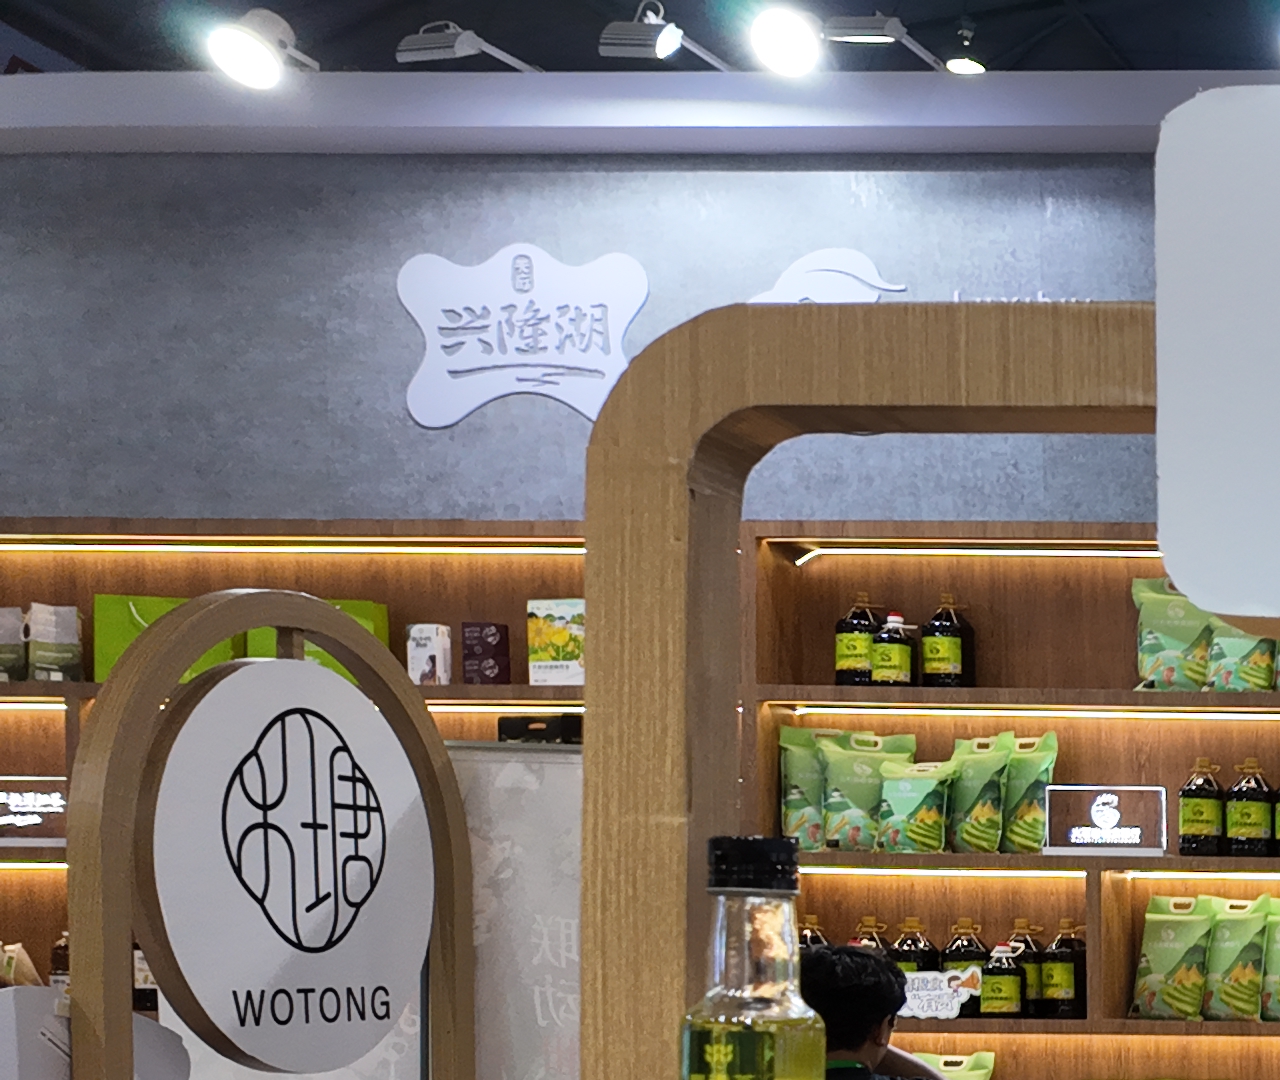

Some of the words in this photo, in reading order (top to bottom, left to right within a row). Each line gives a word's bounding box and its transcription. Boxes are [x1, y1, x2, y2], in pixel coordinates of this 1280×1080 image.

[437, 299, 611, 356] 兴隆湖
[232, 986, 390, 1027] WOTONG
